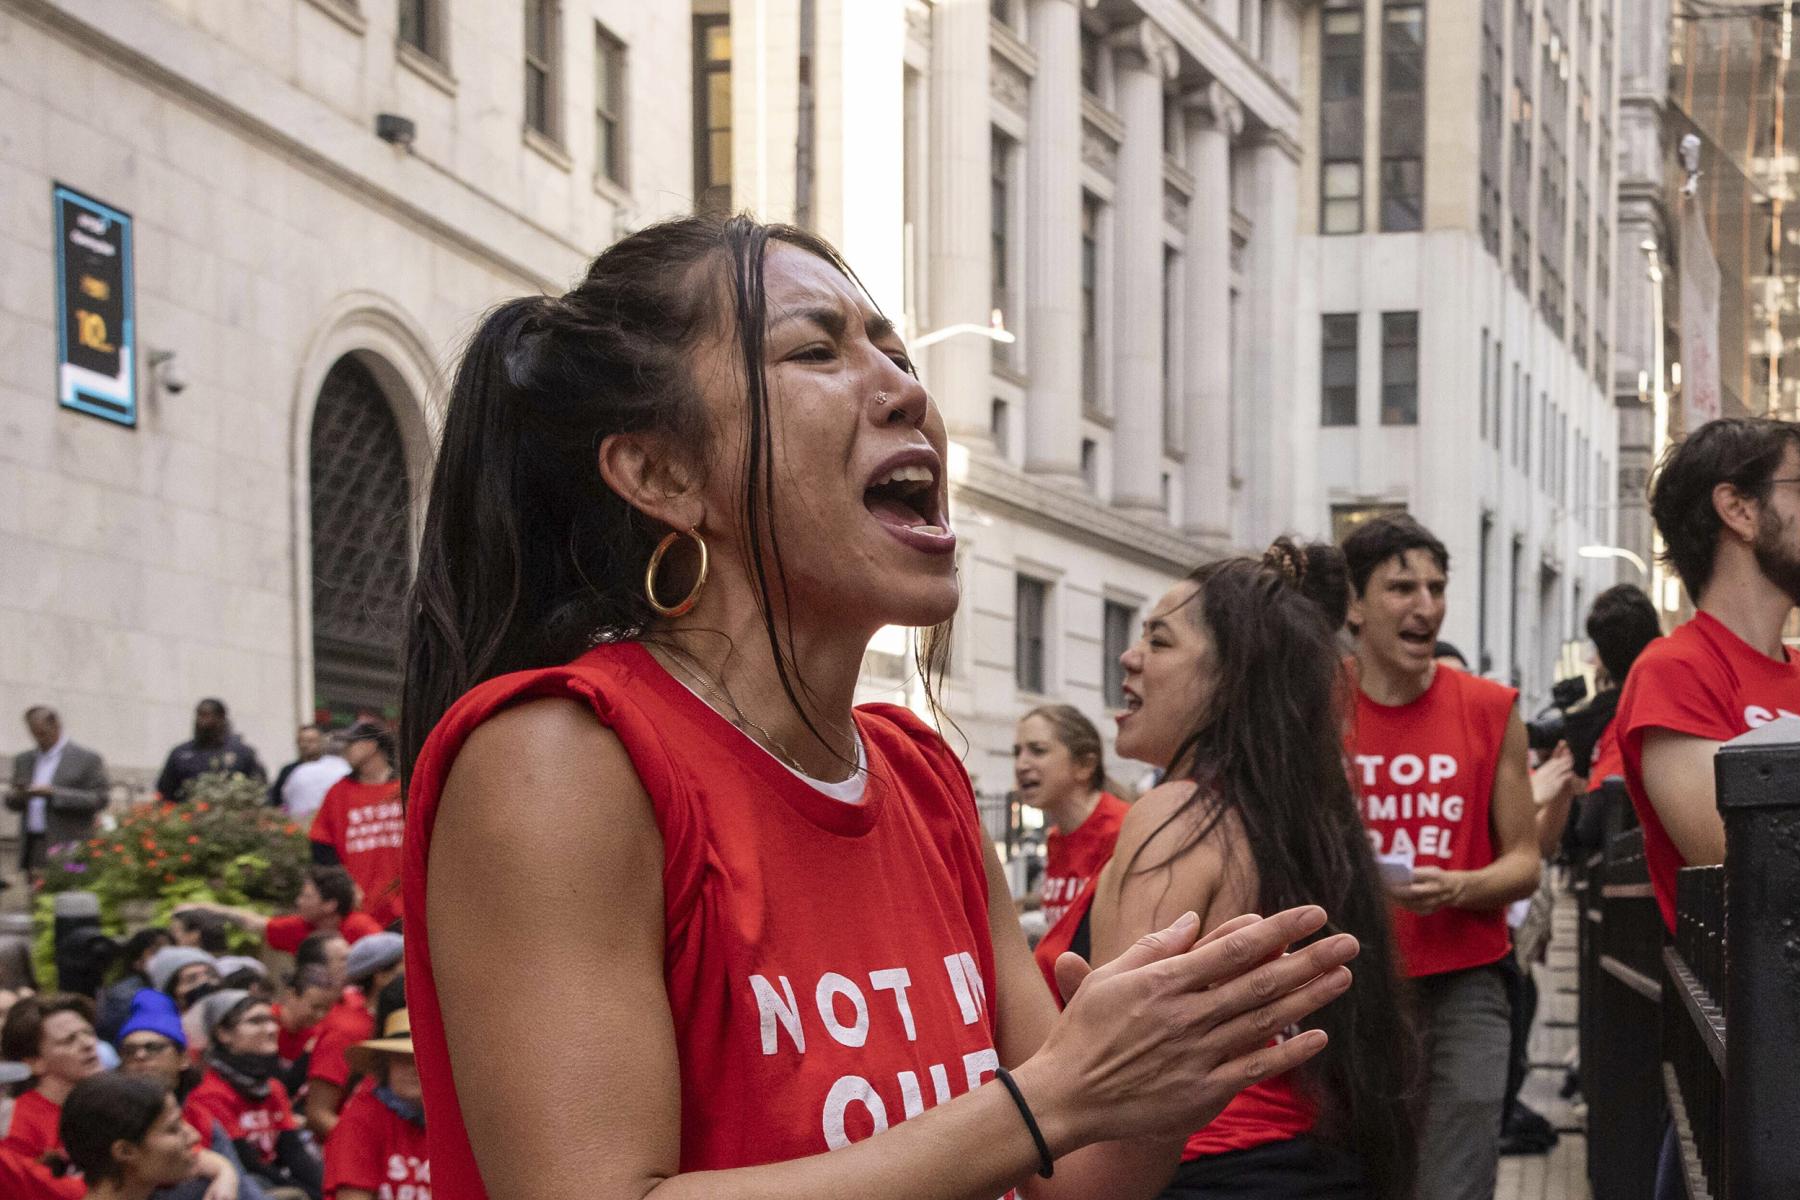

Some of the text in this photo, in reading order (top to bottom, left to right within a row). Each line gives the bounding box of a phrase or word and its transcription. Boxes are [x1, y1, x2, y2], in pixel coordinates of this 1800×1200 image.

[1342, 752, 1458, 786] TOP
[1356, 793, 1464, 822] MING
[748, 967, 913, 1055] NOT
